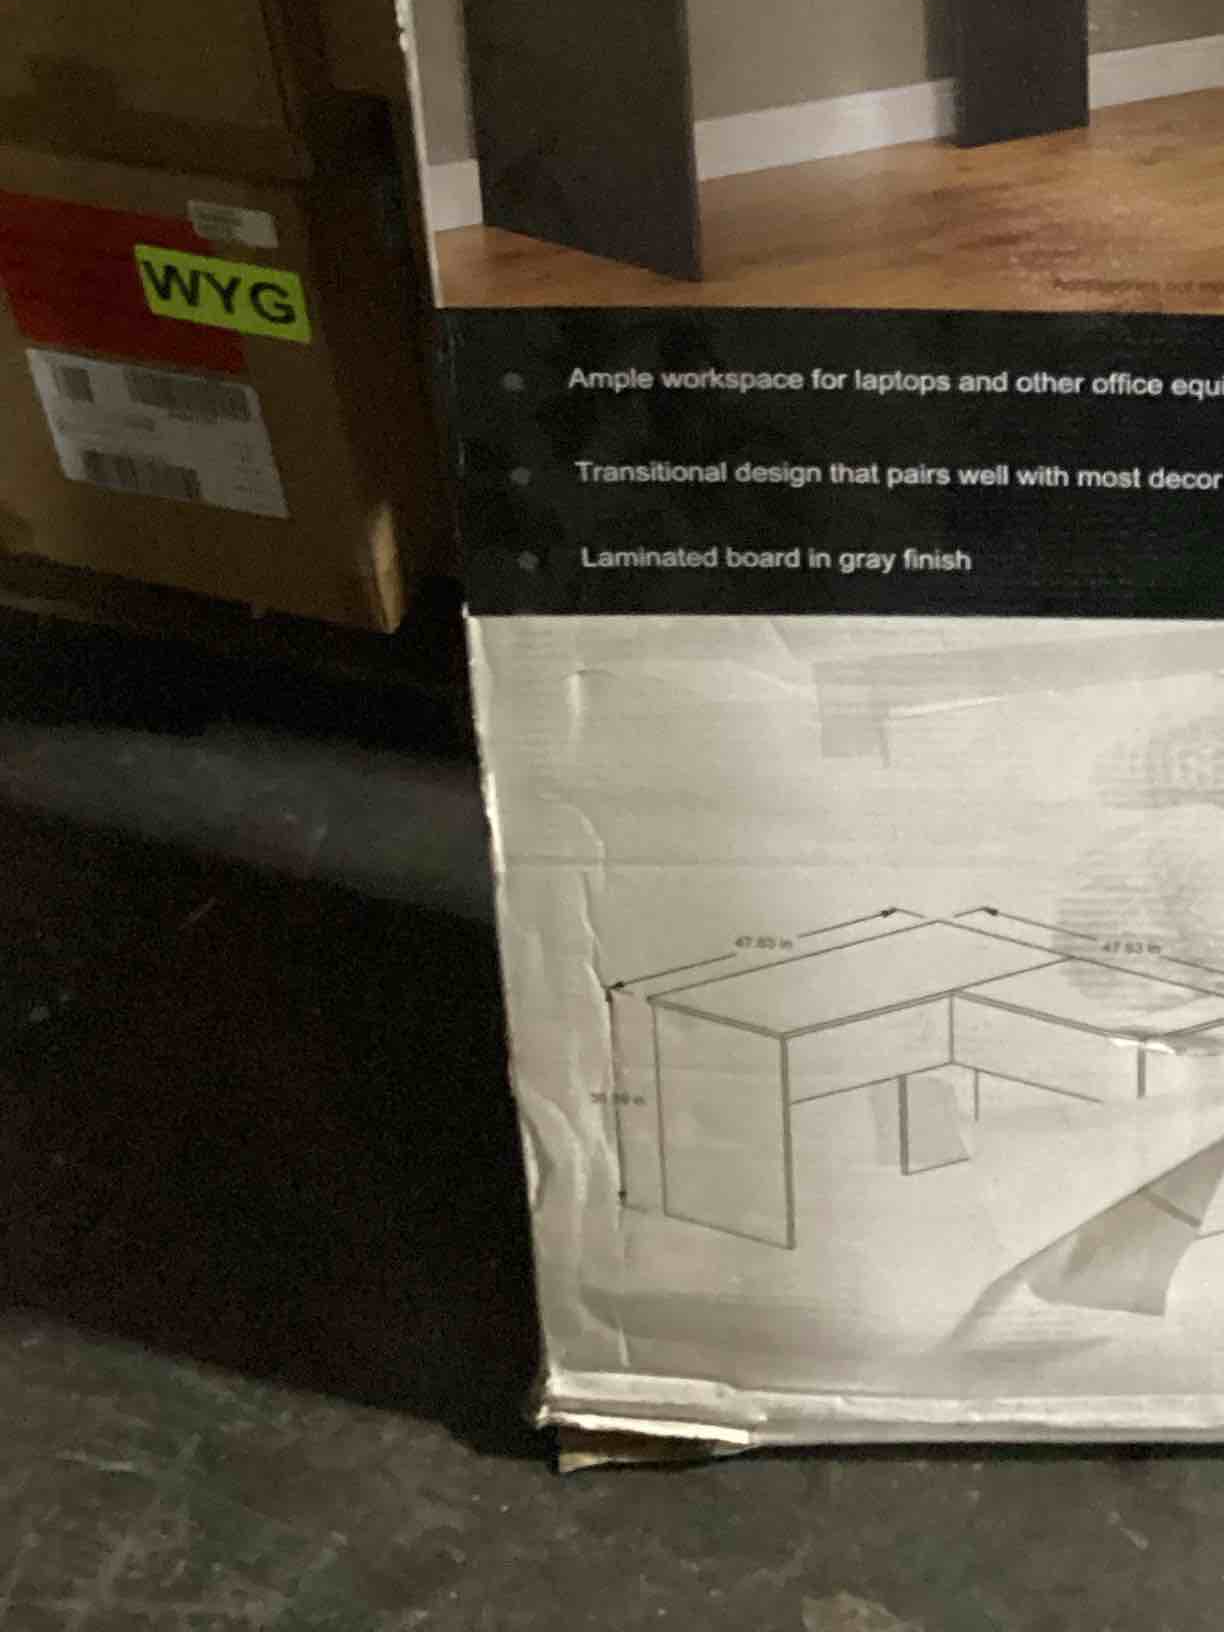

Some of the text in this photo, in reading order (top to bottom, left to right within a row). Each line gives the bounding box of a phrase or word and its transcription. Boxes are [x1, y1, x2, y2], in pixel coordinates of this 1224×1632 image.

[143, 260, 296, 325] WYG
[569, 368, 653, 393] Ample
[661, 369, 804, 394] workspace
[811, 368, 847, 390] for
[855, 369, 950, 395] laptops
[958, 370, 1008, 393] and
[1016, 372, 1083, 397] other
[1091, 372, 1163, 398] office
[576, 460, 727, 485] Transitional
[735, 461, 822, 488] design
[829, 461, 879, 485] that
[887, 462, 951, 489] pairs
[957, 463, 1009, 486] well
[1016, 465, 1069, 489] with
[1077, 467, 1142, 490] most
[1149, 466, 1222, 491] decor
[581, 546, 972, 574] Laminated board in gray finish
